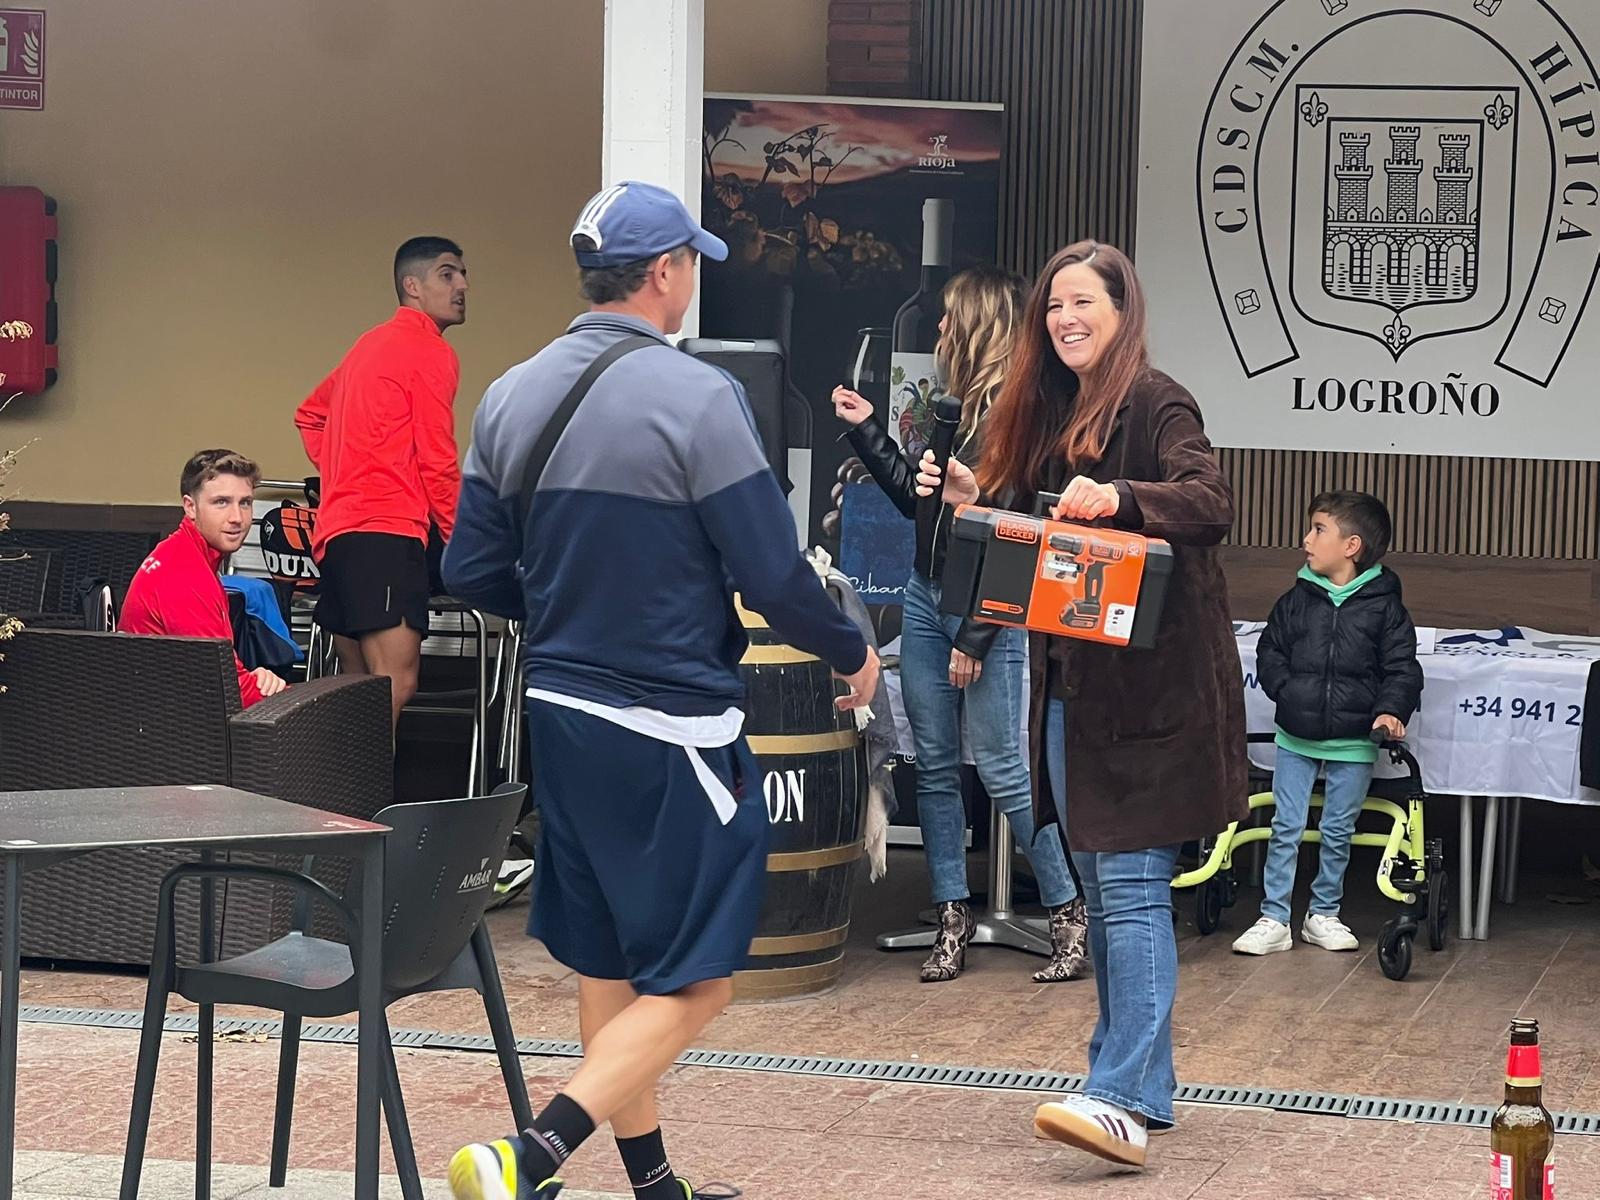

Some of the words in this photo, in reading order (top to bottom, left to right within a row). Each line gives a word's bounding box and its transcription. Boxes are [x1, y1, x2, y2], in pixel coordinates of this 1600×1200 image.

[1529, 41, 1600, 243] HÍPICA
[1291, 372, 1500, 417] LOGROÑO
[1000, 528, 1034, 540] DECKER
[1459, 696, 1502, 717] +34
[1511, 697, 1556, 723] 941
[458, 869, 493, 889] AMBAR
